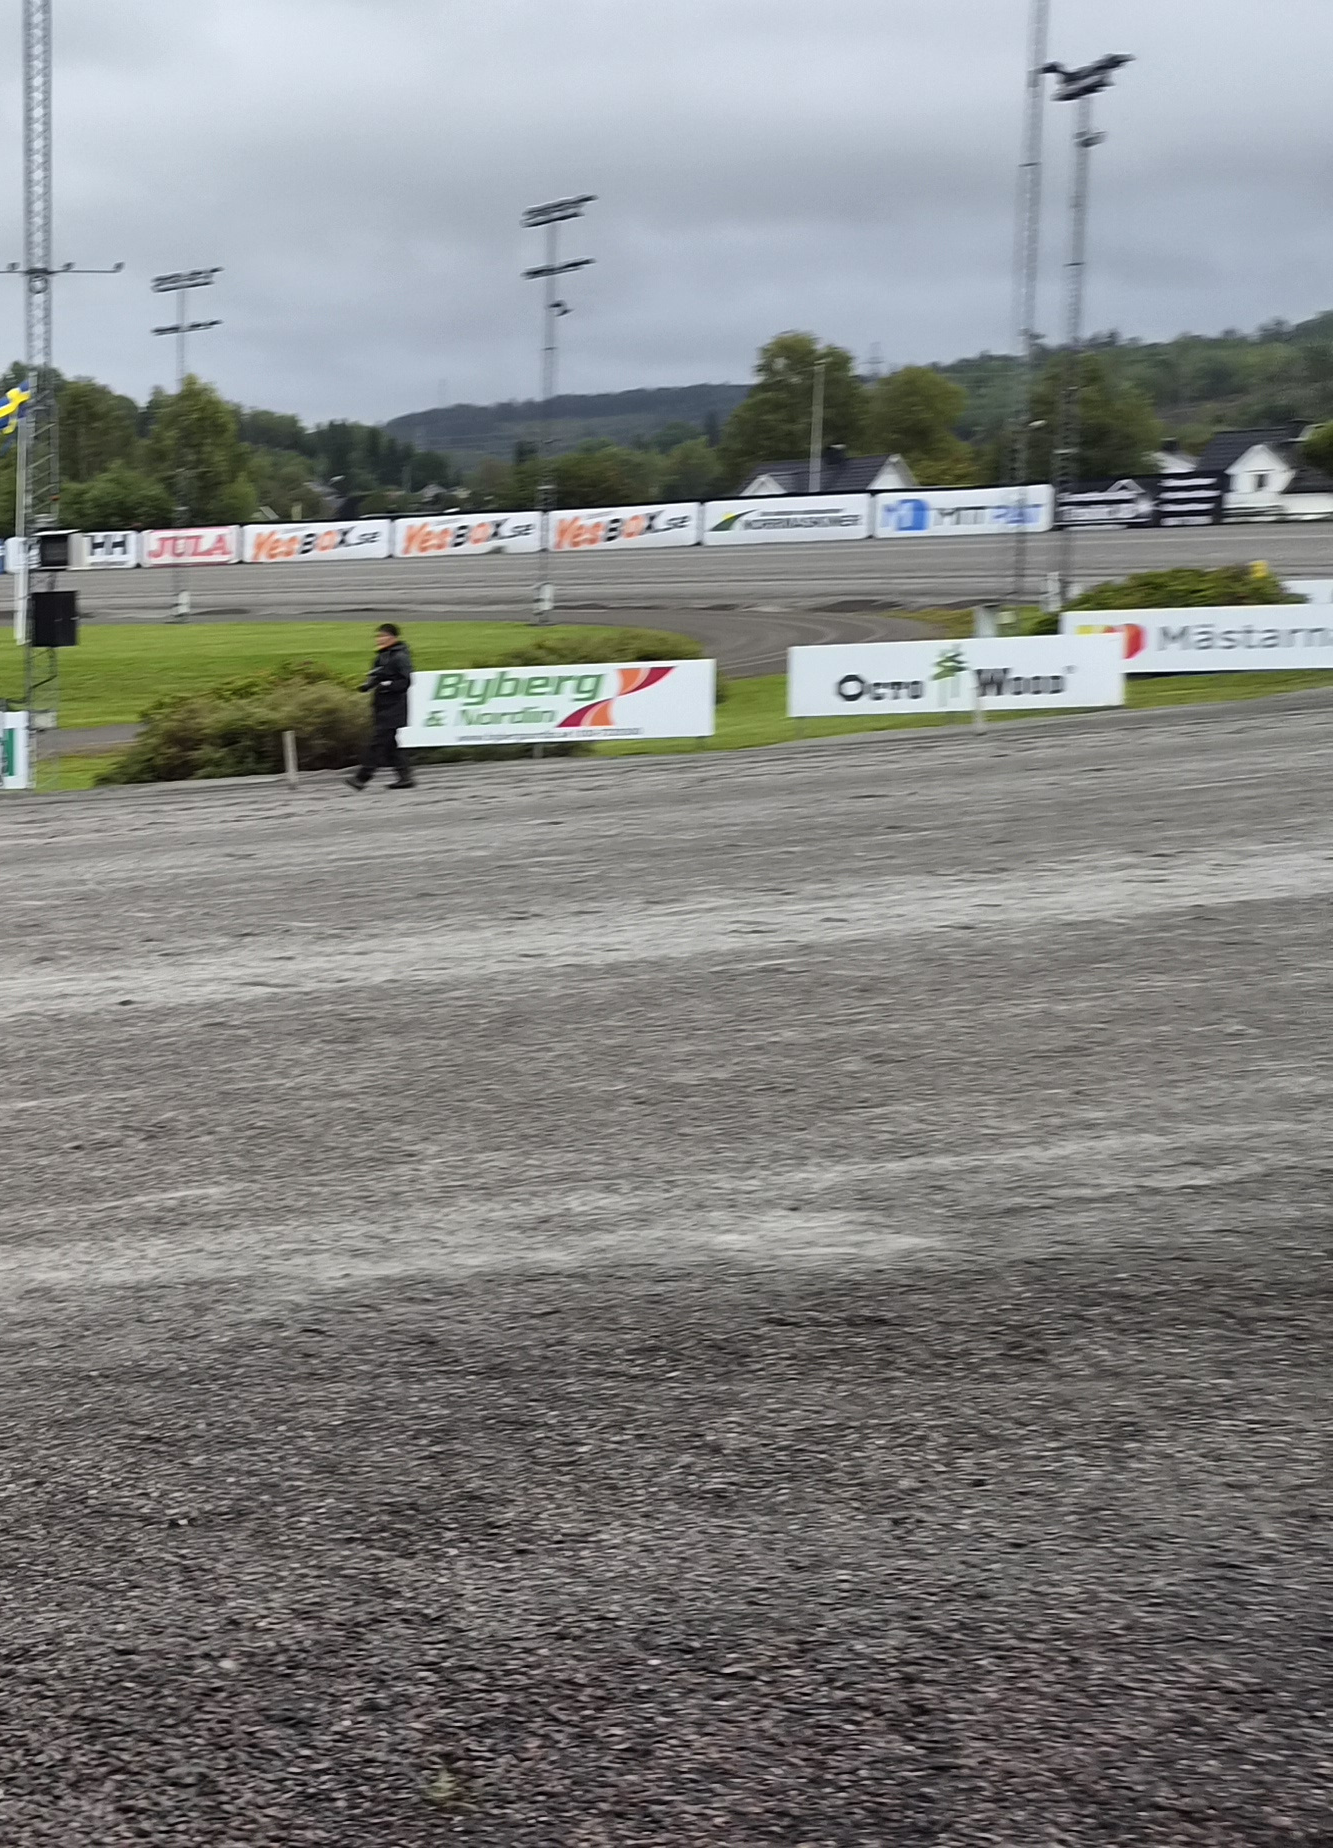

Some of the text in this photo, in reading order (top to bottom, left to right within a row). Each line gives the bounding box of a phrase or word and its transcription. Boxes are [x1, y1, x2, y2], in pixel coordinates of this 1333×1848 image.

[148, 534, 232, 559] JULA
[433, 671, 606, 706] Byberg
[423, 706, 557, 728] & Nordin
